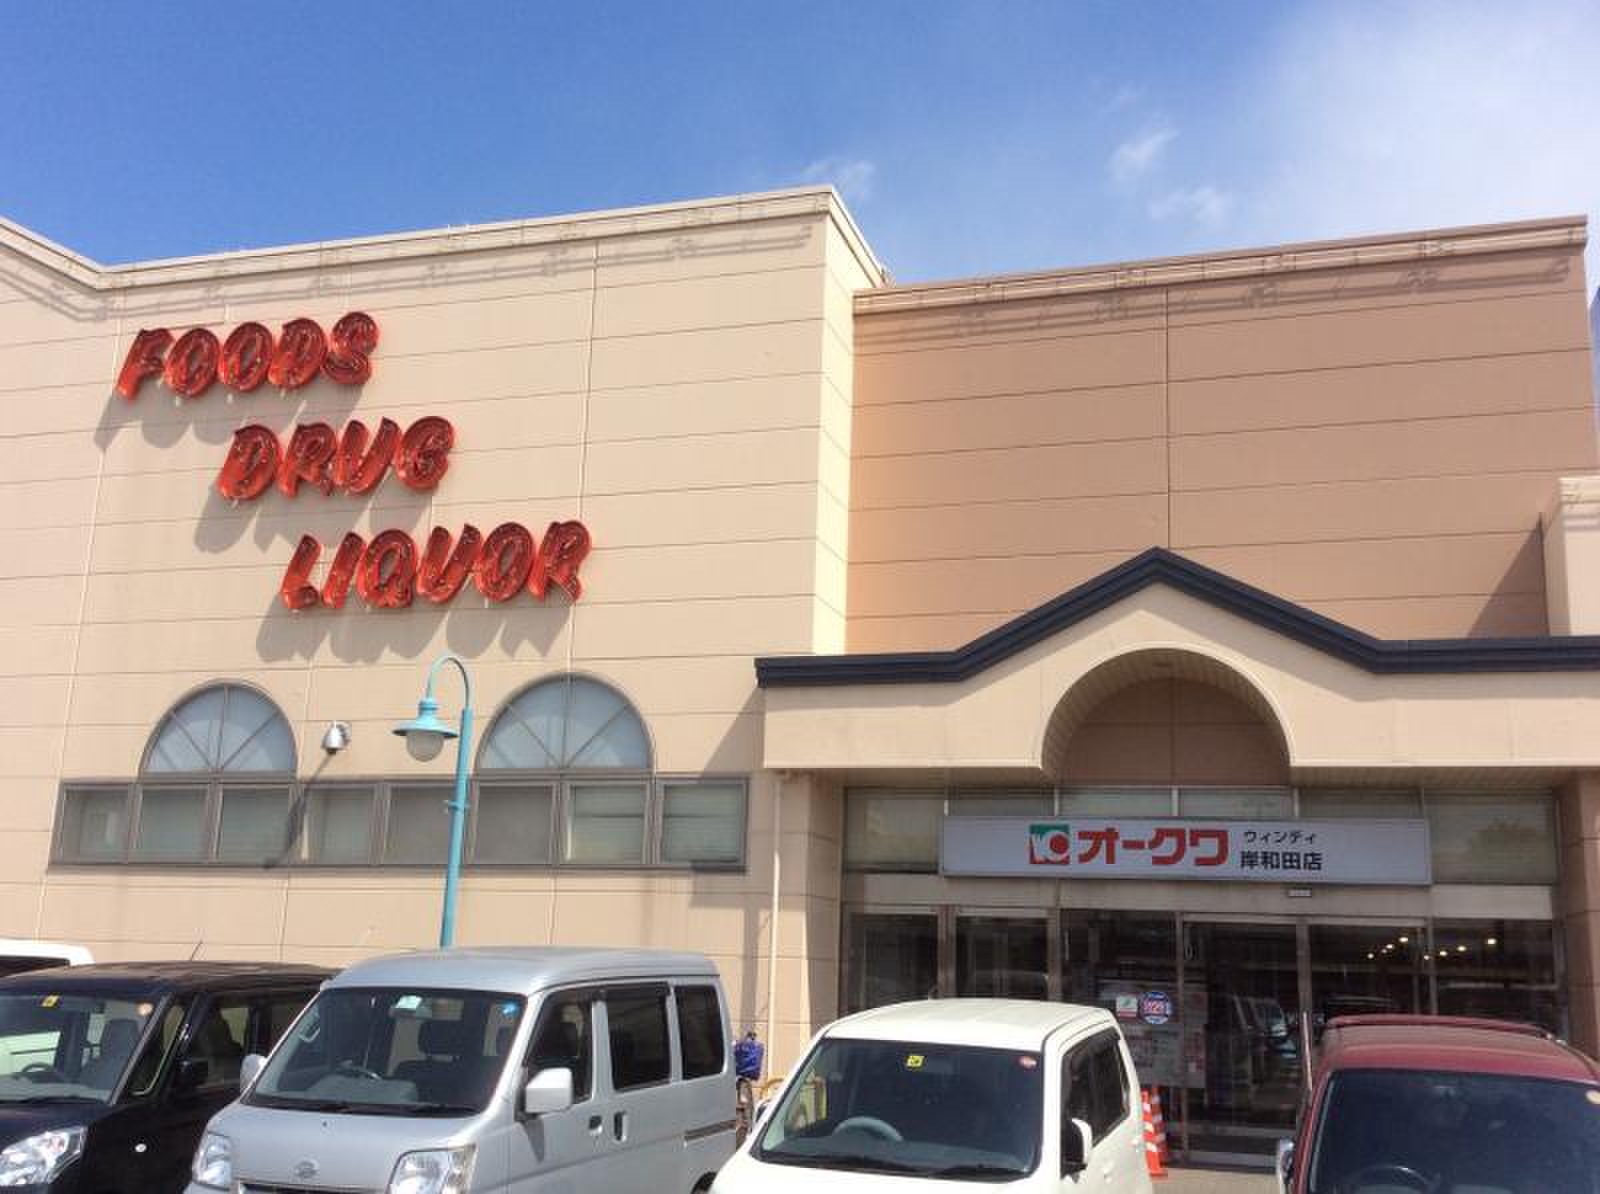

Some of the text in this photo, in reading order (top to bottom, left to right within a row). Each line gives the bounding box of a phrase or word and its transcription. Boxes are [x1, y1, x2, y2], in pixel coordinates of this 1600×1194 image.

[115, 311, 380, 402] FOODS
[217, 415, 456, 502] DRUG
[280, 519, 593, 611] LIQUOR
[1077, 827, 1229, 867] オークワ
[1240, 851, 1322, 871] 岸和田店
